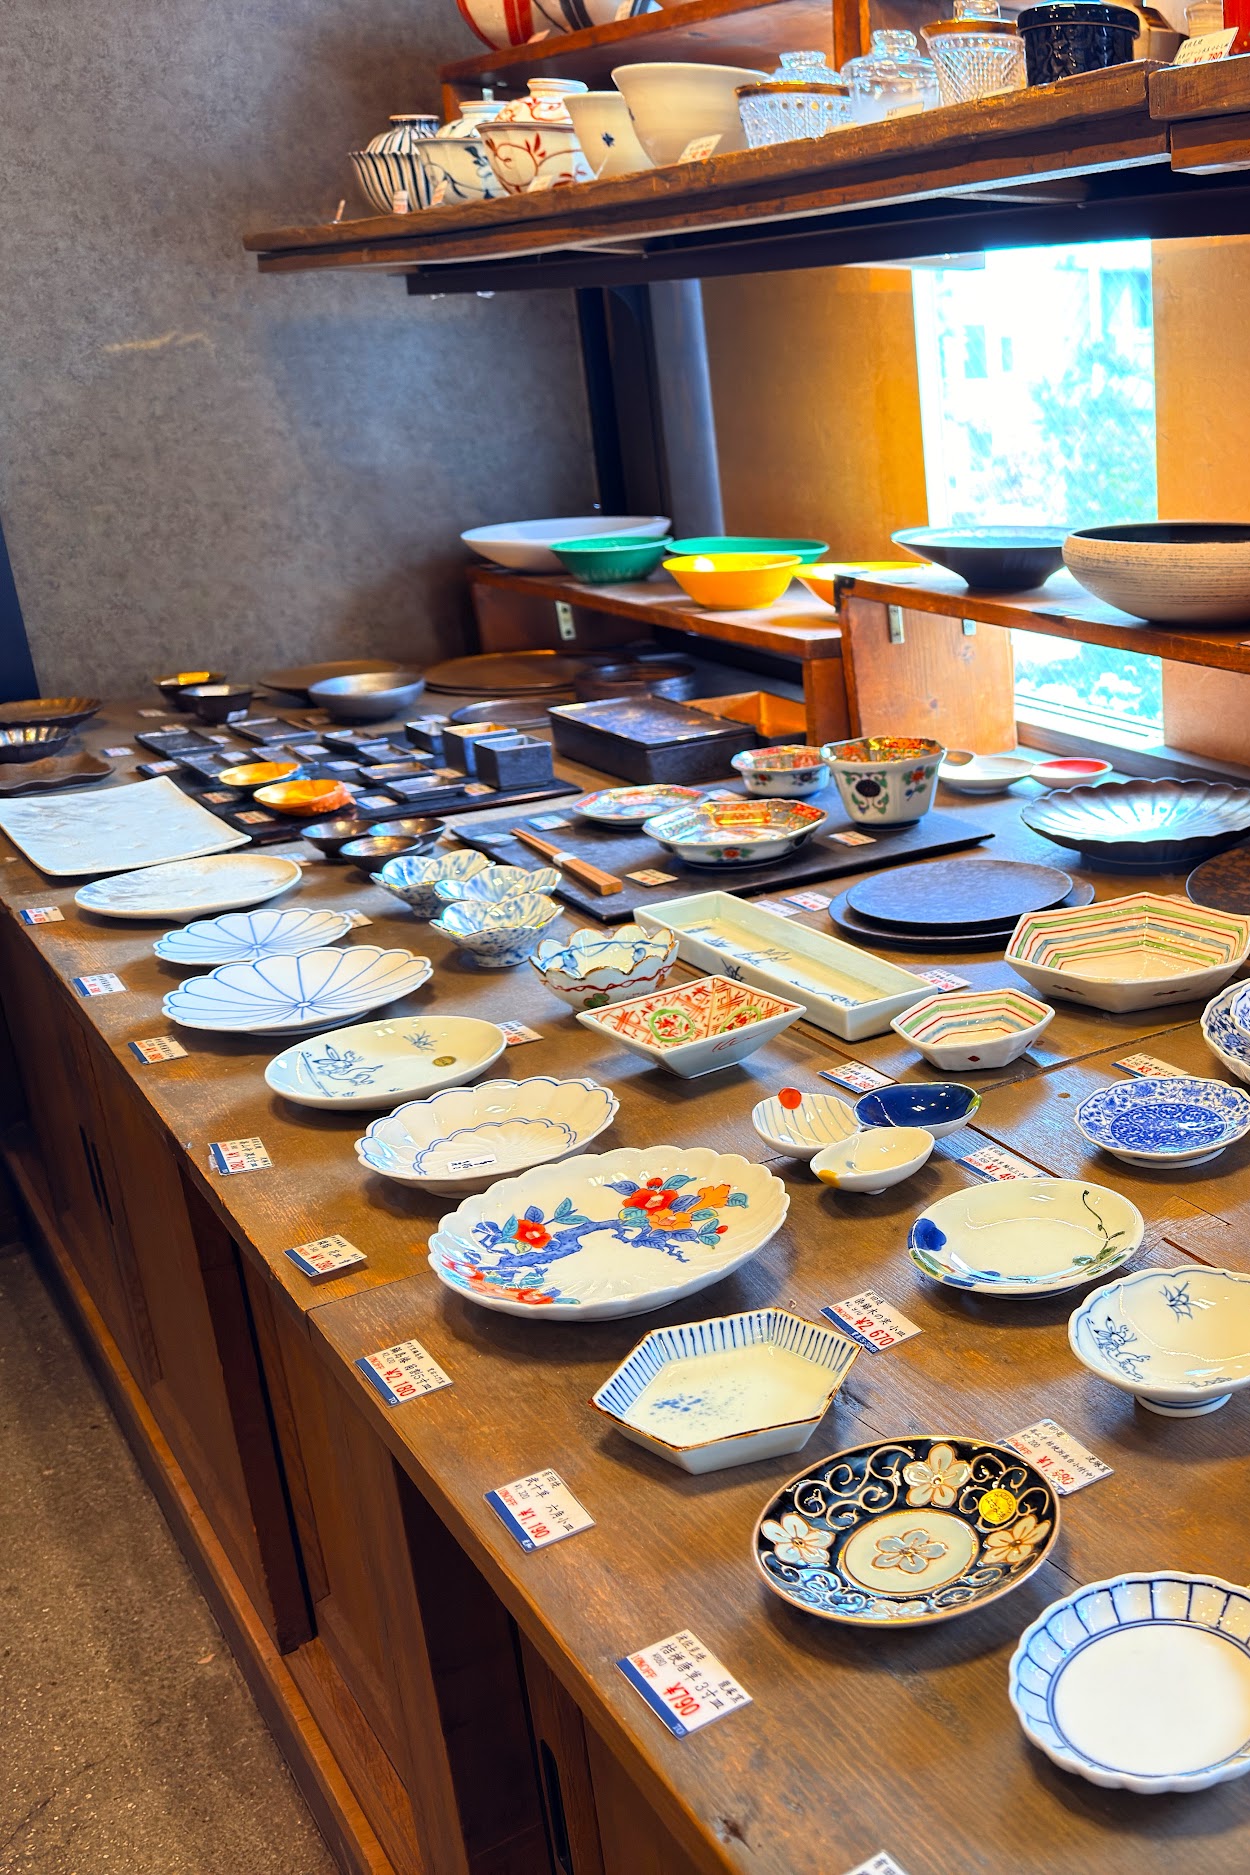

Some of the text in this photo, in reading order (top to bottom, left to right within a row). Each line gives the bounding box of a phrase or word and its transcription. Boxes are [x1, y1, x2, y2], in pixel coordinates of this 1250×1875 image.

[854, 1316, 895, 1346] ¥2,670
[383, 1367, 417, 1397] ¥2,180
[517, 1507, 550, 1539] ¥1,190
[545, 1504, 574, 1531] 六角小皿
[675, 1633, 707, 1662] 波佐見焼
[631, 1654, 658, 1679] 10%OFF
[659, 1642, 725, 1710] 桔梗唐草 3寸皿
[663, 1681, 700, 1717] ¥790
[672, 1723, 685, 1735] TO
